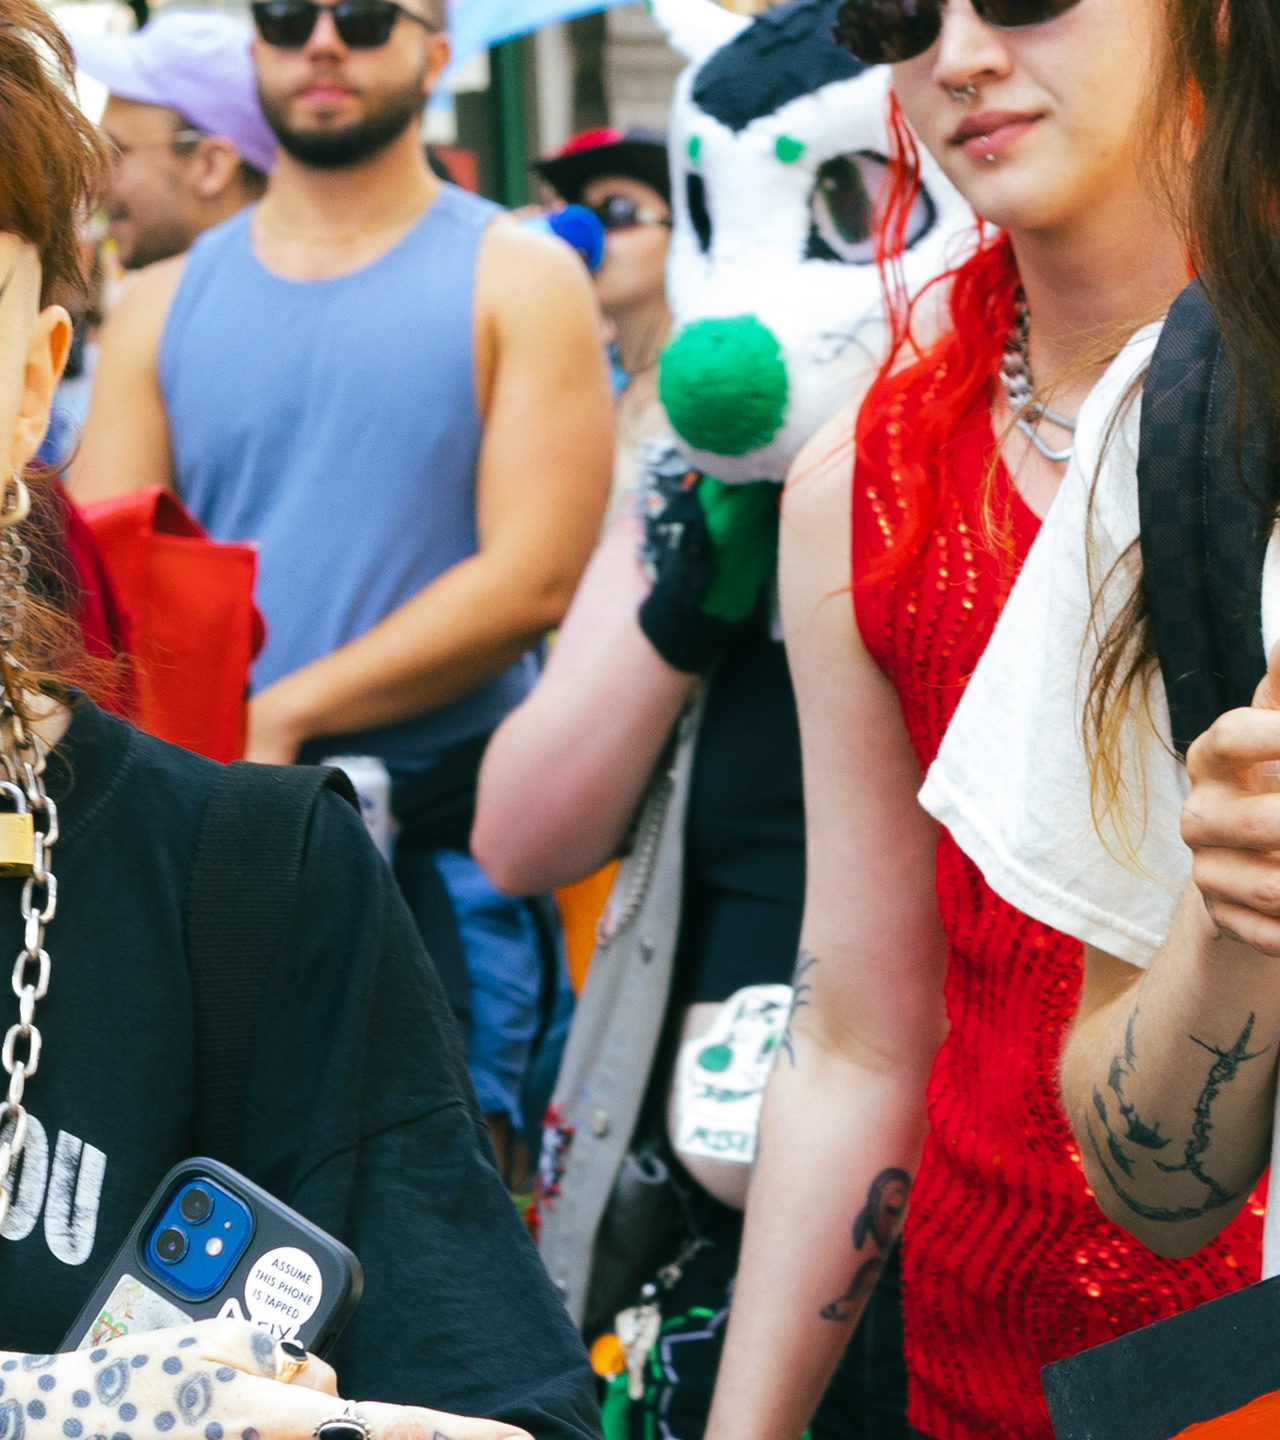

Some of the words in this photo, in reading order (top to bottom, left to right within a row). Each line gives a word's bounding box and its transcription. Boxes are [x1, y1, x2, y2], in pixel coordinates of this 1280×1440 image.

[272, 1259, 312, 1284] ASSUME
[255, 1270, 276, 1286] THIS
[279, 1282, 314, 1306] PHONE
[253, 1289, 262, 1301] IS
[265, 1295, 299, 1319] TAPPED
